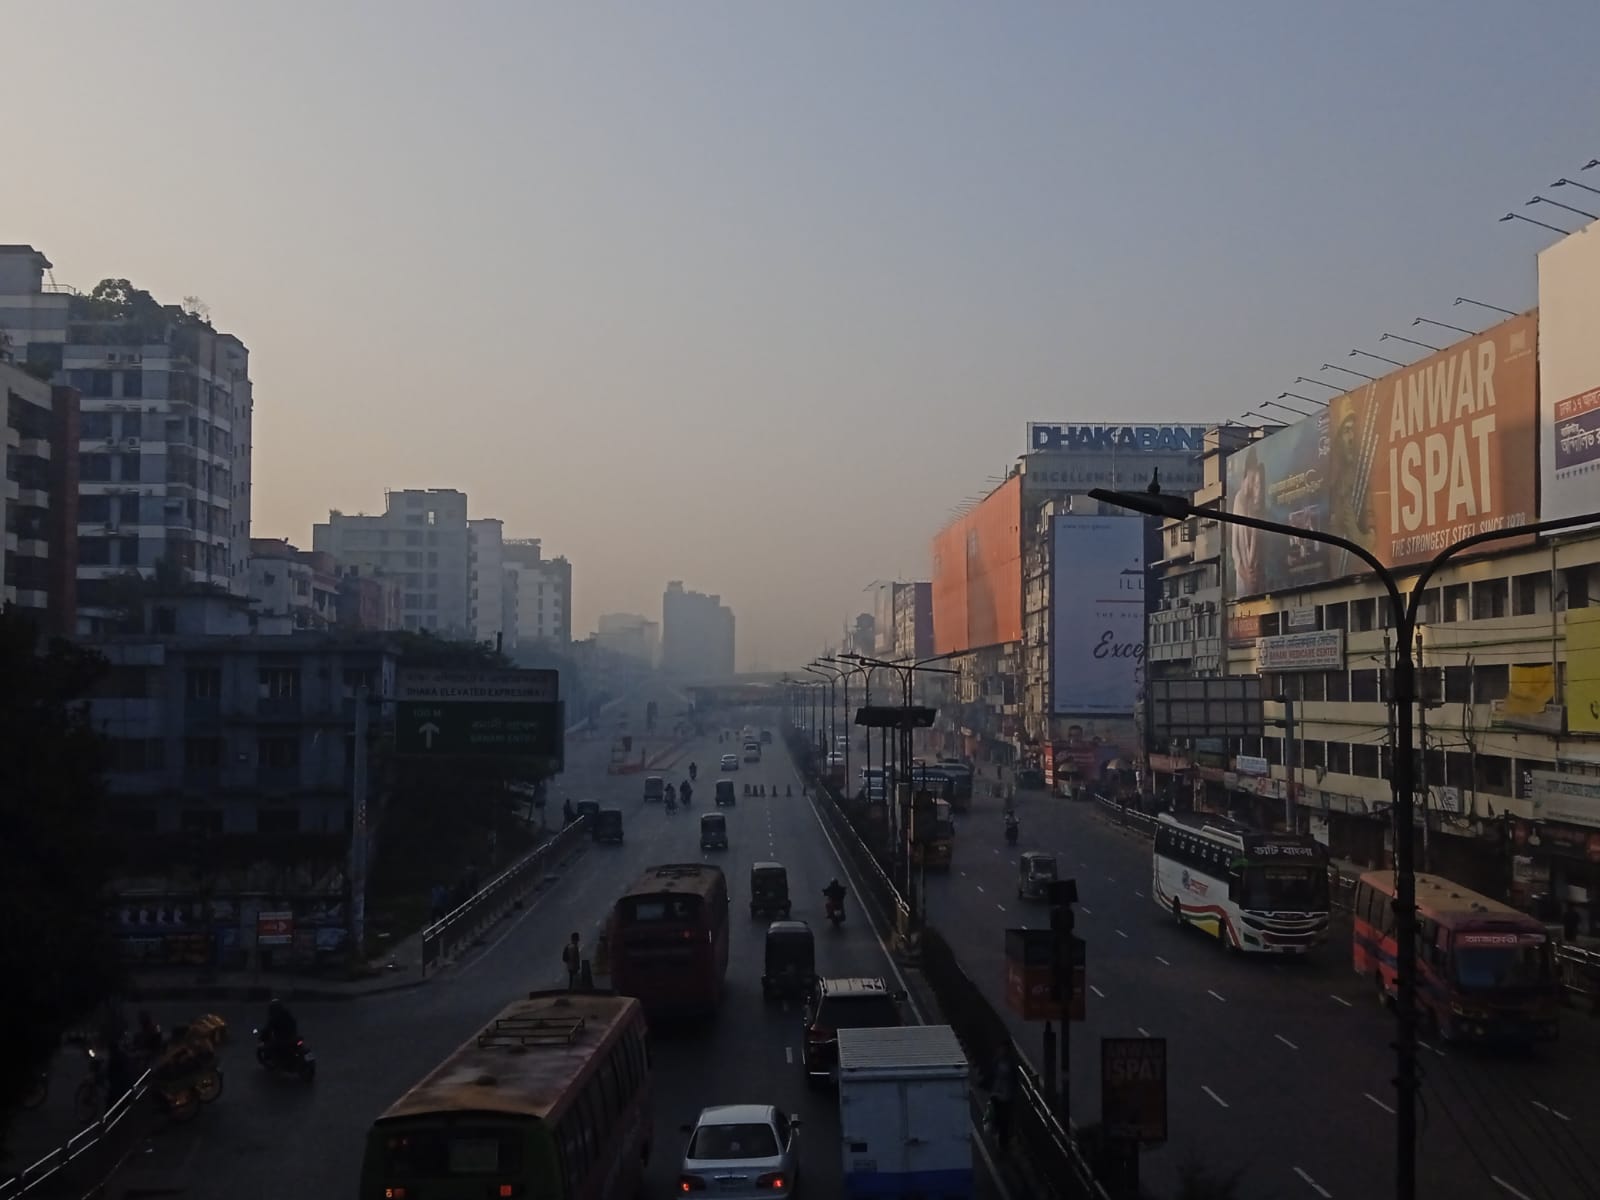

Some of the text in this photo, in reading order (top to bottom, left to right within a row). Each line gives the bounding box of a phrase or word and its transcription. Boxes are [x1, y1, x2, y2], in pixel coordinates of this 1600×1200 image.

[1389, 339, 1496, 443] ANWAR
[1390, 413, 1496, 535] ISPAT
[1391, 537, 1405, 557] THE
[1406, 528, 1451, 555] STRONGEST
[1452, 523, 1477, 544] STEEL
